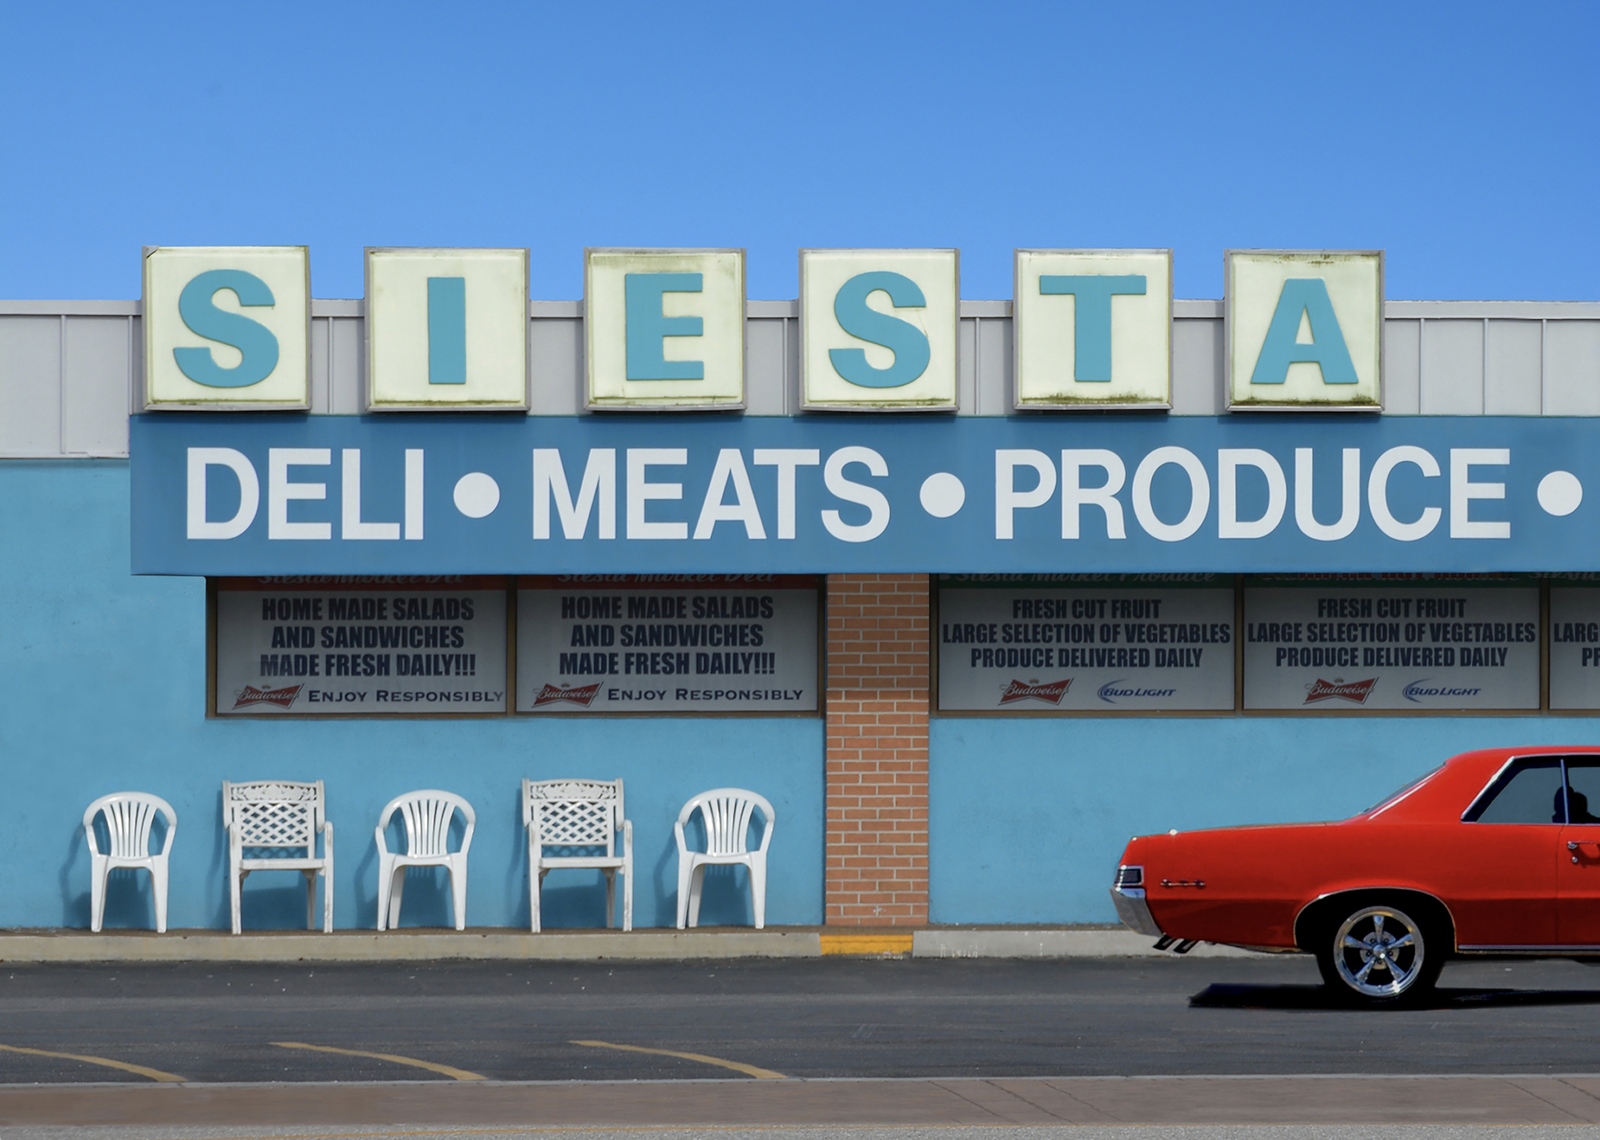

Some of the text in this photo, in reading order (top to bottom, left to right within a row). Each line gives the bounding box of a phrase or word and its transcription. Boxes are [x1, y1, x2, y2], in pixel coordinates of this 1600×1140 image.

[172, 268, 1359, 389] SIESTA
[186, 446, 1511, 543] DELI MEATS PRODUCE
[262, 597, 475, 621] HOME MADE SALADS
[561, 595, 774, 619] HOME MADE SALADS
[1012, 598, 1163, 620] FRESH CUT FRUIT
[1317, 597, 1468, 619] FRESH CUT FRUIT
[271, 625, 465, 649] AND SANDWICHES
[570, 623, 764, 647] AND SANDWICHES
[942, 622, 1231, 644] LARGE SELECTION OF VEGETABLES
[1247, 622, 1536, 643] LARGE SELECTION OF VEGETABLES
[1553, 622, 1600, 643] LARG
[260, 653, 476, 677] MADE FRESH DAILY!!!
[559, 652, 776, 675] MADE FRESH DAILY!!!
[970, 647, 1204, 668] PRODUCE DELIVERED DAILY
[1275, 646, 1509, 667] PRODUCE DELIVERED DAILY
[309, 689, 504, 703] ENJOY RESPONSIBLY
[607, 688, 804, 701] ENJOY RESPONSIBLY
